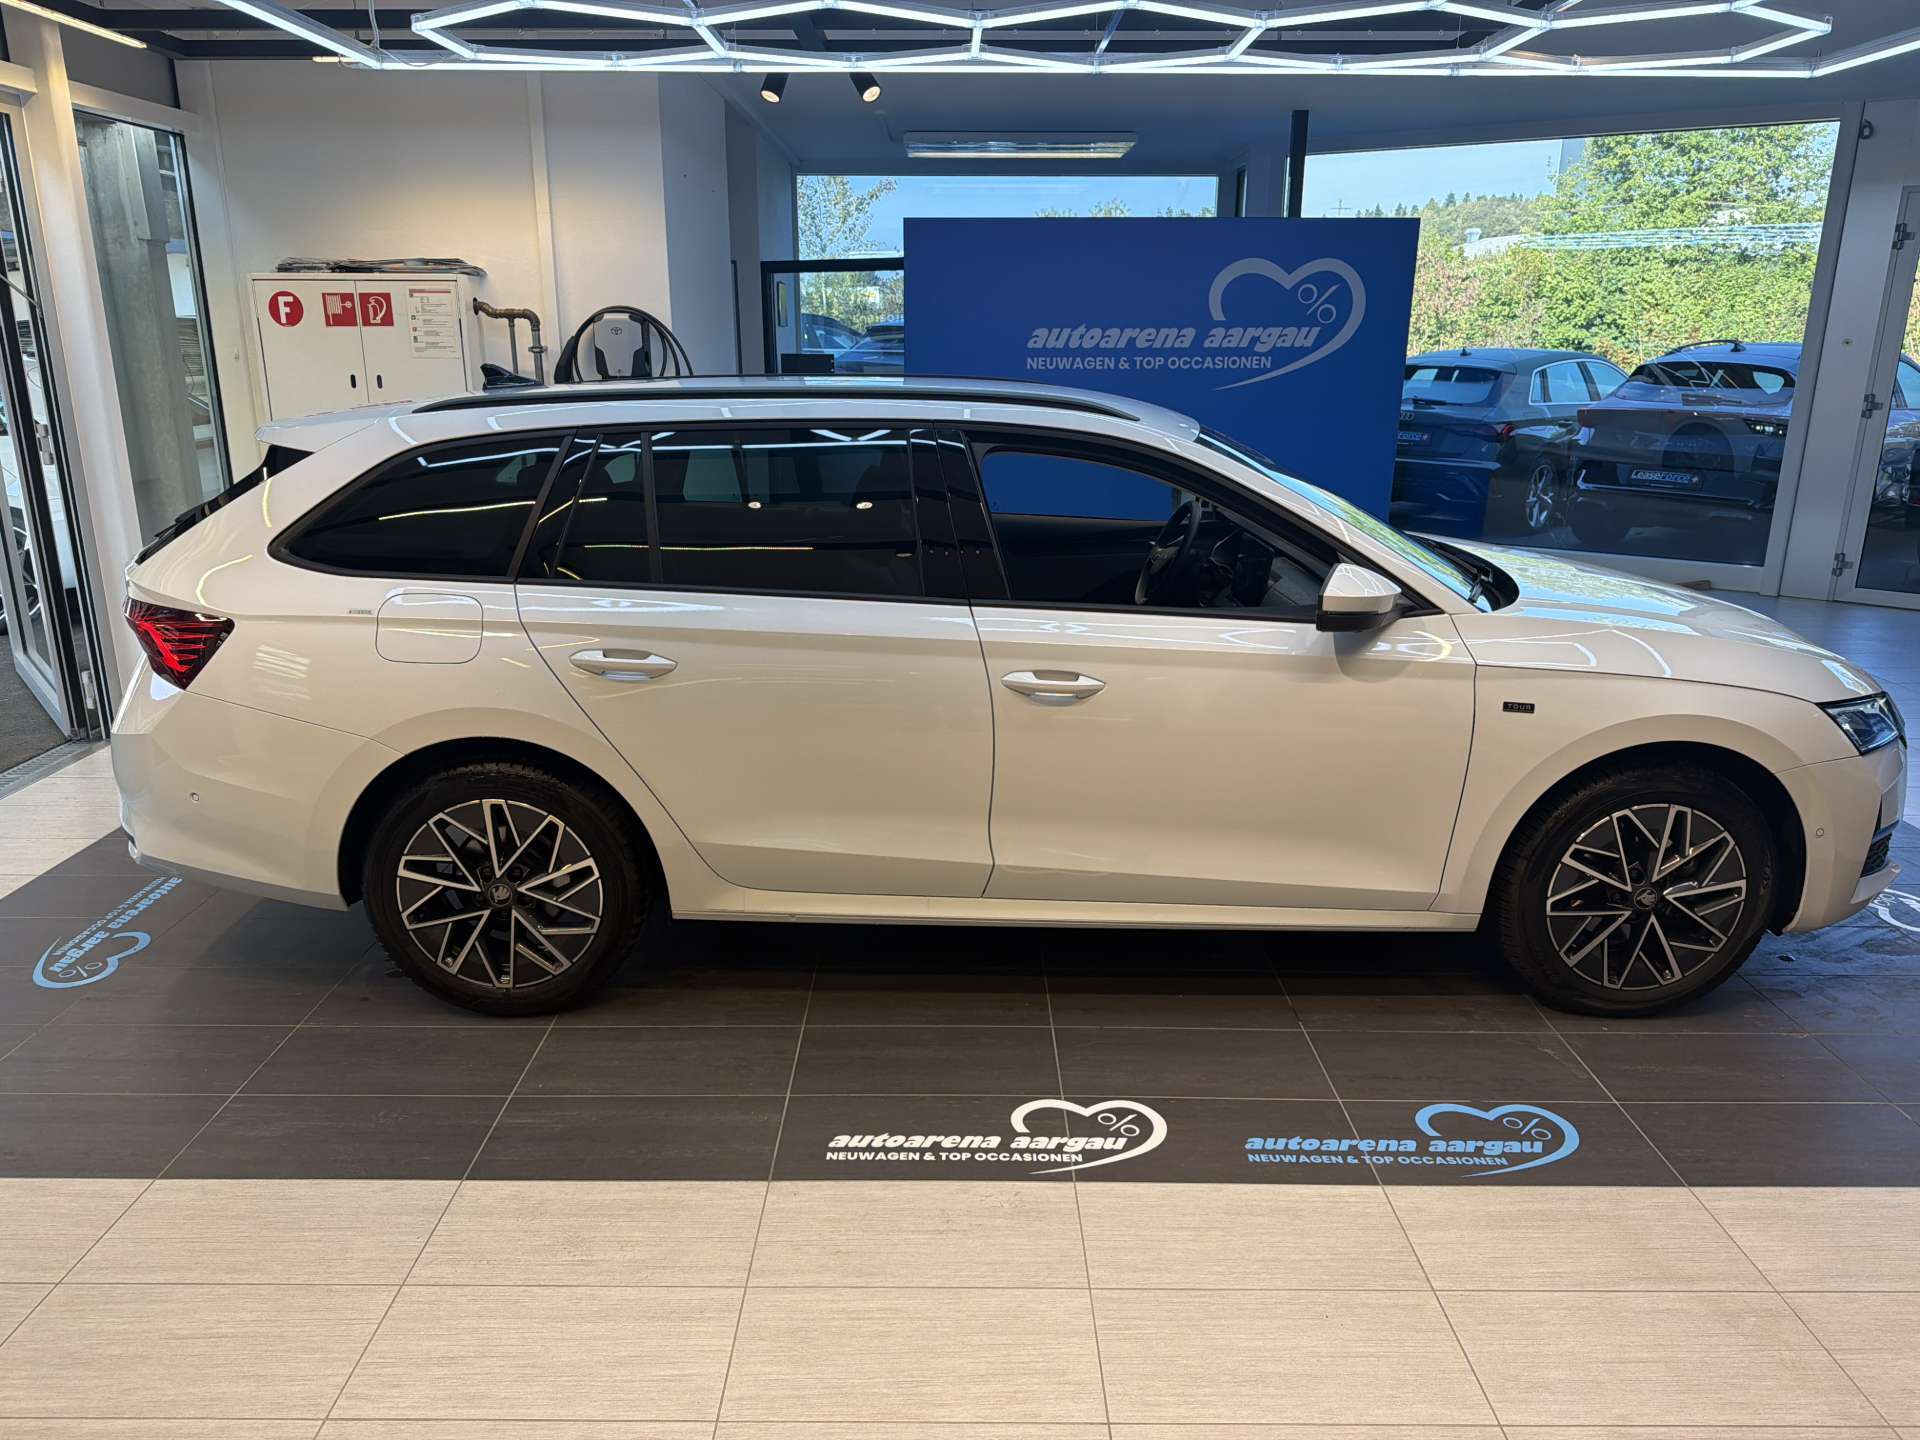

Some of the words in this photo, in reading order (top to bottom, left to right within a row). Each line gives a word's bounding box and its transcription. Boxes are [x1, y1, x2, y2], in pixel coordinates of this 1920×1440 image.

[278, 296, 293, 323] F
[1026, 323, 1196, 349] autoarena
[1203, 326, 1321, 352] aargau
[1026, 356, 1115, 369] NEUWAGEN
[1118, 356, 1130, 369] &
[1133, 357, 1164, 369] TOP
[1167, 356, 1272, 369] OCCASIONEN
[828, 1132, 1001, 1149] autoarena
[1010, 1135, 1128, 1152] aargau
[1244, 1135, 1417, 1152] autoarena
[1428, 1138, 1543, 1156] aargau
[826, 1151, 920, 1161] NEUWAGEN
[924, 1152, 936, 1161] &
[939, 1152, 972, 1161] TOP
[975, 1152, 1083, 1163] OCCASIONEN
[1247, 1153, 1343, 1164] NEUWAGEN
[1346, 1155, 1359, 1164] &
[1362, 1155, 1394, 1165] TOP
[1398, 1155, 1509, 1166] OCCASIONEN
